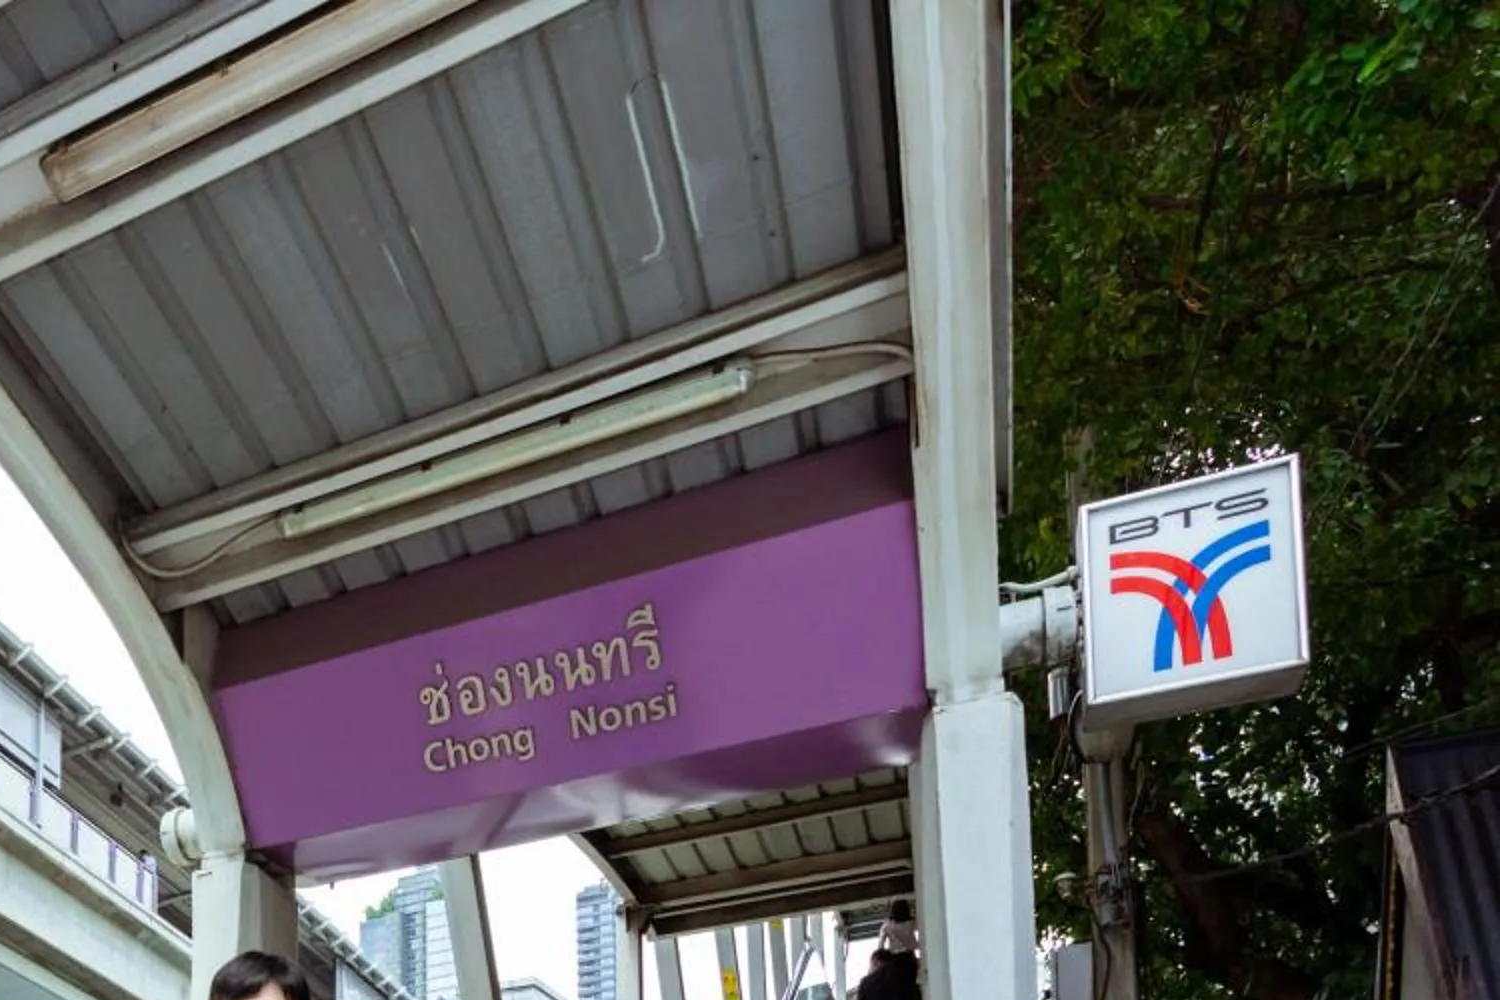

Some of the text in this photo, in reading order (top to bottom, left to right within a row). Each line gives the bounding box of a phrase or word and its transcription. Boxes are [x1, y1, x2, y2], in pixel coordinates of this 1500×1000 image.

[1108, 487, 1269, 545] BTS
[419, 604, 662, 725] ช่องนนทรี
[423, 684, 678, 773] Chong Nonsi
